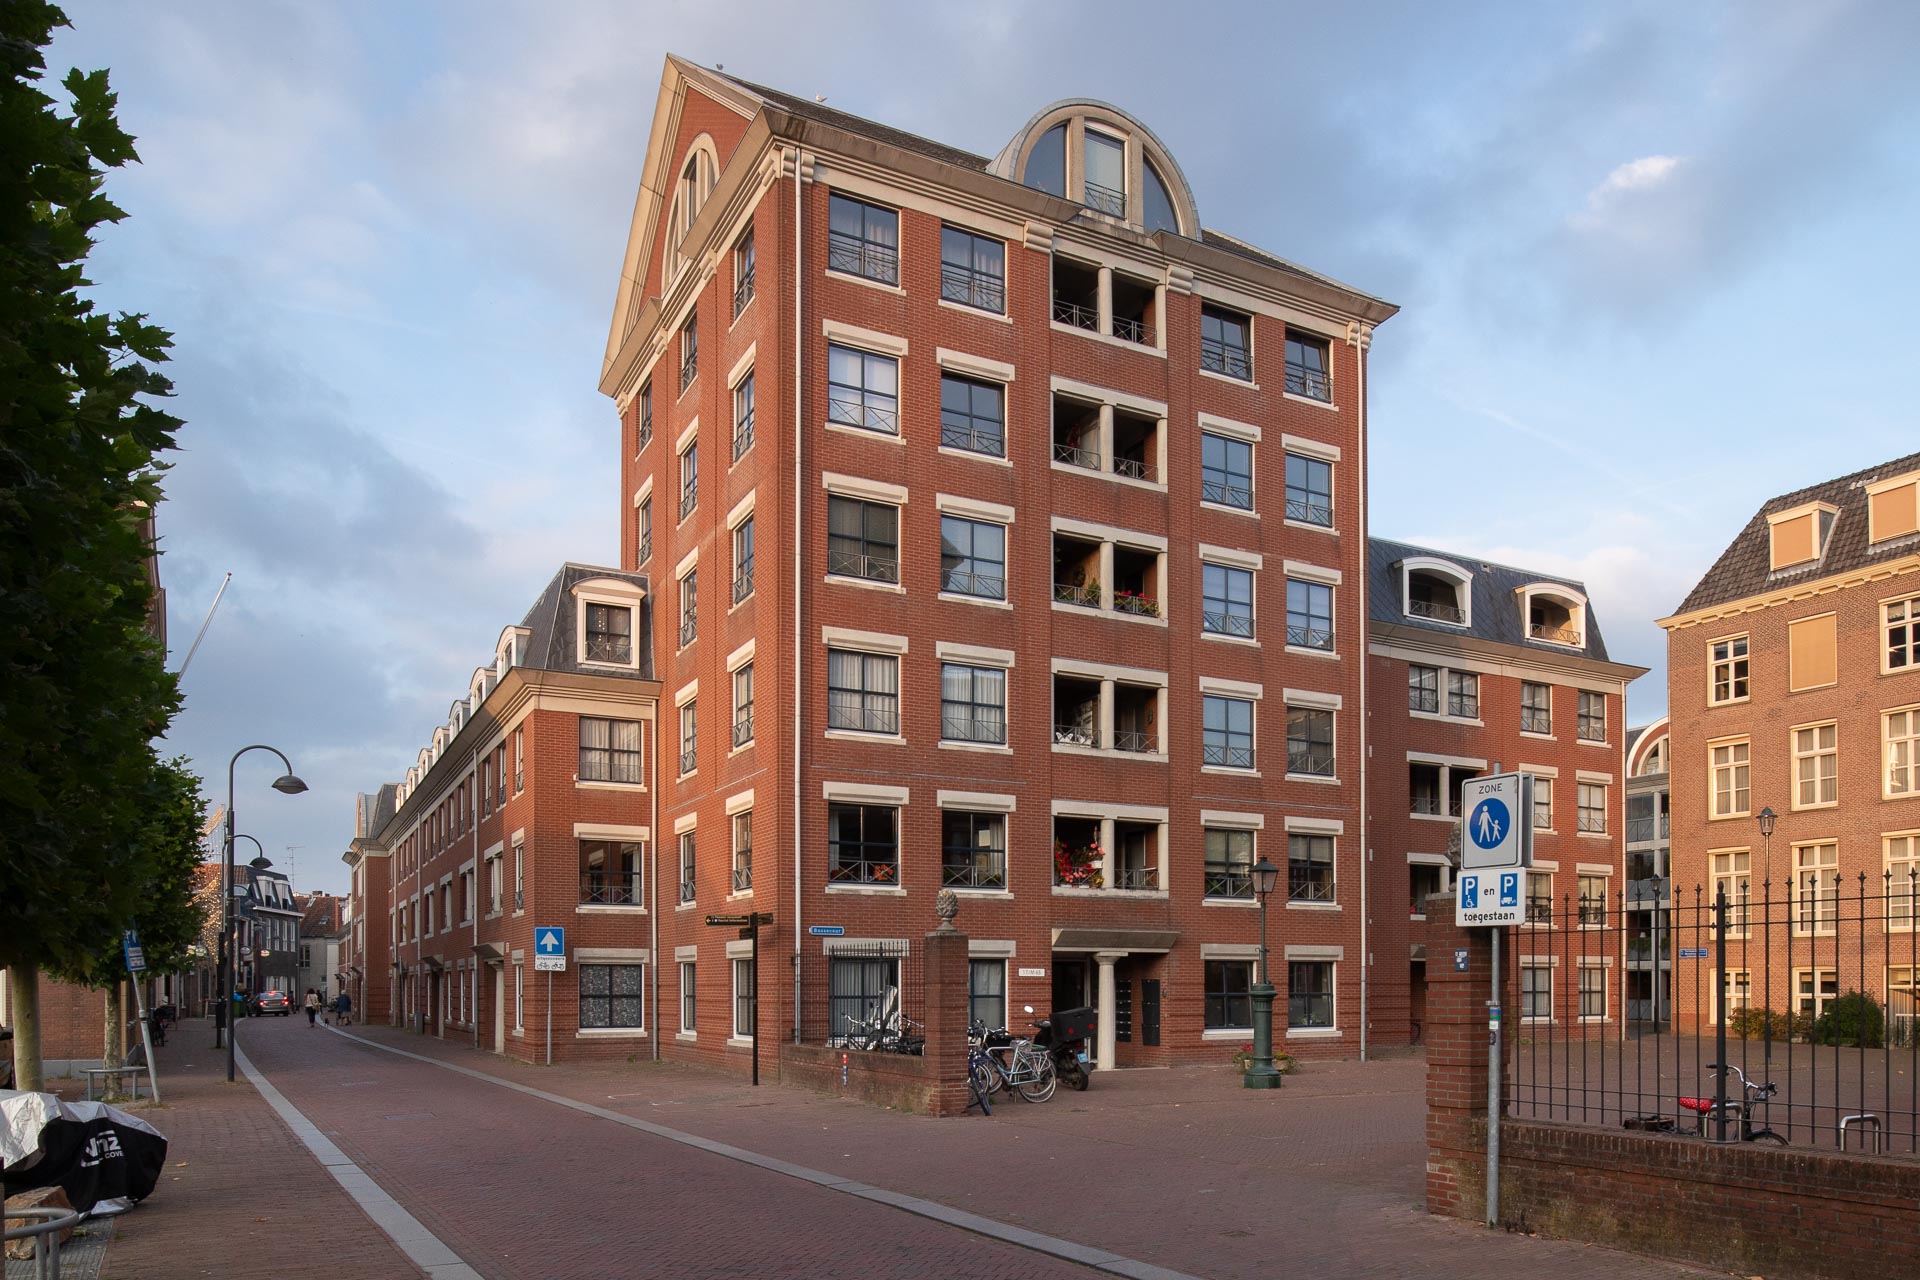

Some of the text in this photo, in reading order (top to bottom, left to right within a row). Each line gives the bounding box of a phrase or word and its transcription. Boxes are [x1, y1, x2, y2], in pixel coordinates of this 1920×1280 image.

[1478, 783, 1503, 795] ZONE
[1465, 876, 1514, 896] P en P
[1463, 912, 1515, 923] toegestaan
